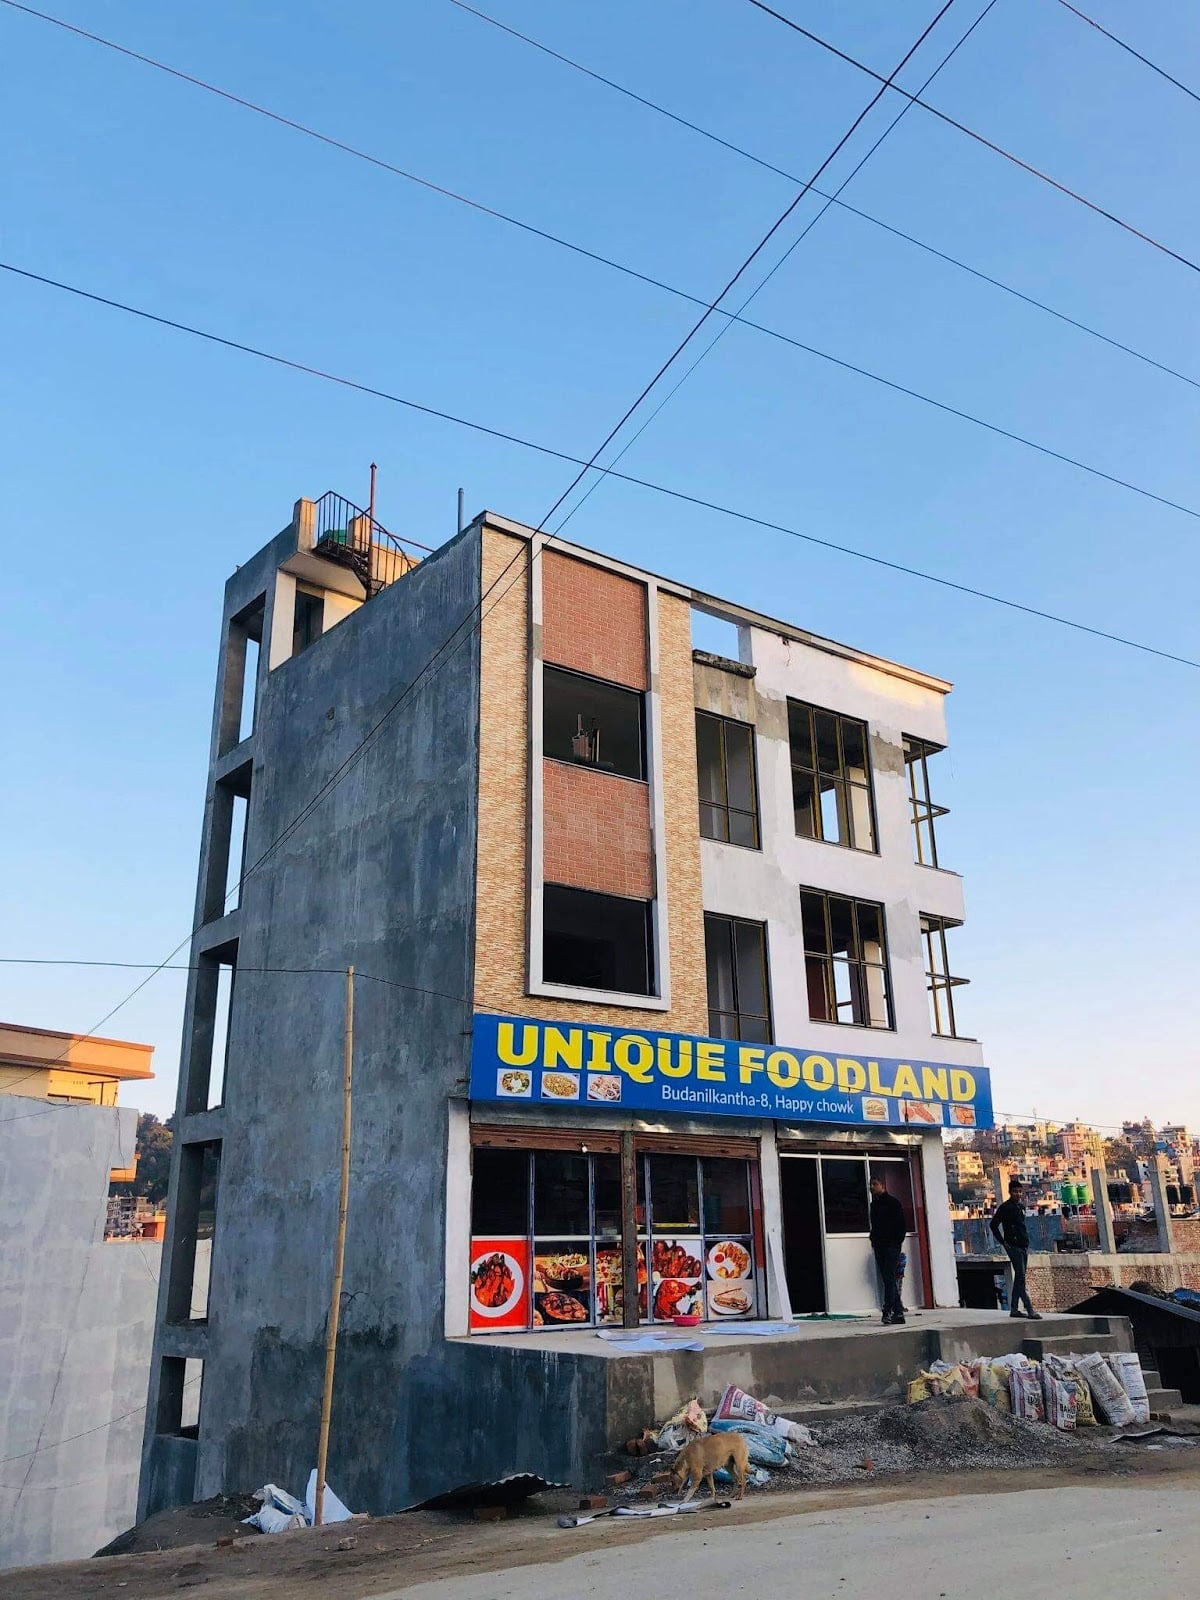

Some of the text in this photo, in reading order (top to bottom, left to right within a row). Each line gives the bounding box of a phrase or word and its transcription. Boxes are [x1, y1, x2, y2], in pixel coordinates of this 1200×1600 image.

[497, 1022, 976, 1102] UNIQUE FOODLAND
[661, 1085, 854, 1114] Budanilkantha-8, Happy chowk
